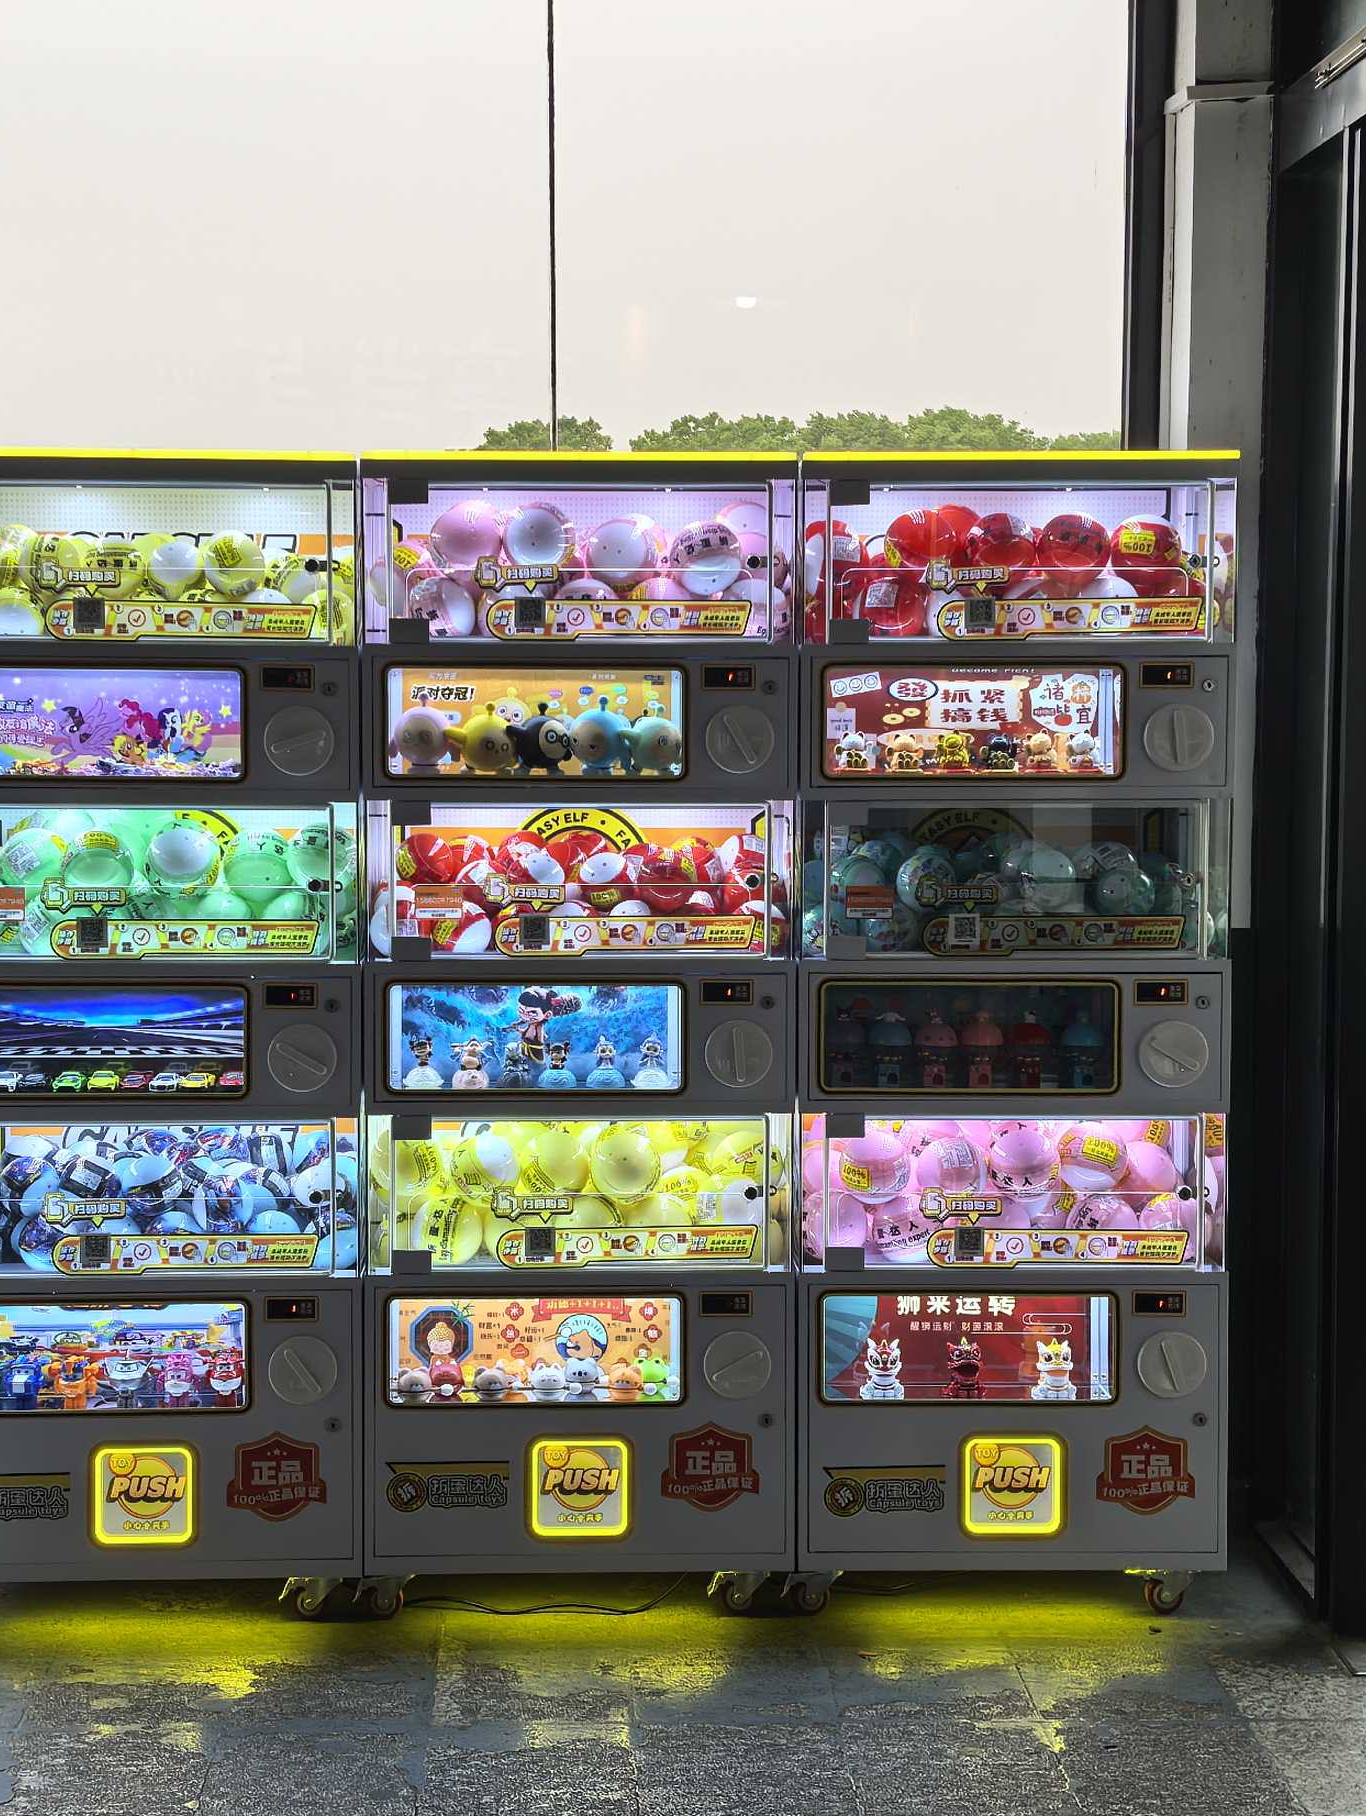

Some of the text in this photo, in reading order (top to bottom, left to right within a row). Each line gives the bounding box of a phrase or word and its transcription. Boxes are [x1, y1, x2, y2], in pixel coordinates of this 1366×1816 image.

[563, 812, 590, 824] ELF
[896, 1295, 1017, 1316] 狮来运转
[251, 1460, 304, 1485] 正品
[685, 1450, 737, 1475] 正品
[1121, 1455, 1172, 1479] 正品
[110, 1476, 187, 1499] PUSH
[544, 1468, 620, 1491] PUSH
[975, 1466, 1051, 1490] PUSH
